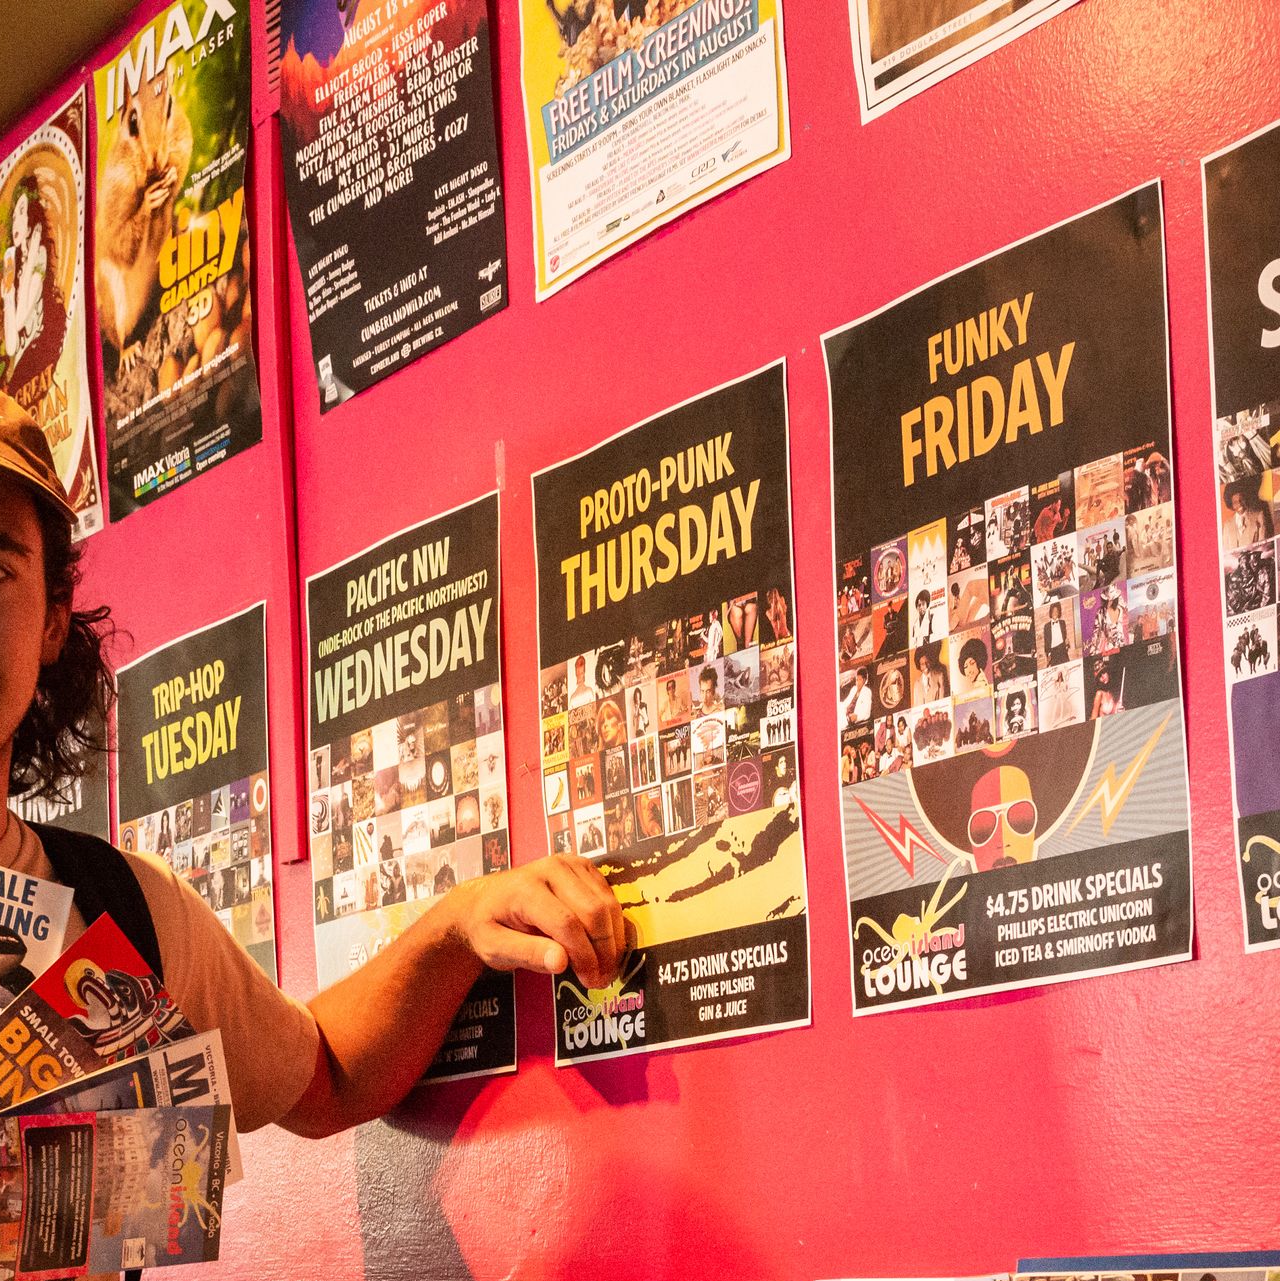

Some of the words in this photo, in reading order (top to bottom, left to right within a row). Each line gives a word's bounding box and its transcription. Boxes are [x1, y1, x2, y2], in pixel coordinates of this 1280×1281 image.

[191, 23, 234, 67] LASER
[398, 31, 432, 64] DEFUNK
[899, 33, 940, 58] DOUGLAS
[549, 84, 594, 136] FREE
[593, 61, 634, 104] FILM
[551, 116, 597, 159] FRIDAYS
[599, 108, 609, 124] &
[611, 62, 680, 117] SATURDAYS
[682, 49, 696, 70] IN
[699, 11, 753, 61] AUGUST
[158, 186, 244, 289] tiny
[186, 288, 214, 327] 3D
[927, 292, 1034, 384] FUNKY
[900, 341, 1076, 488] FRIDAY
[579, 431, 736, 540] PROTO-PUNK
[347, 553, 408, 618] PACIFIC
[413, 540, 450, 587] NW
[560, 478, 762, 623] THURSDAY
[364, 617, 374, 637] OF
[375, 609, 390, 631] THE
[391, 595, 424, 626] PACIFIC
[425, 569, 488, 611] NORTHWEST)
[151, 659, 225, 722] TRIP-HOP
[314, 598, 495, 725] WEDNESDAY
[141, 696, 243, 787] TUESDAY
[994, 945, 1021, 968] ICED
[1023, 941, 1042, 963] TEA
[1043, 941, 1054, 960] &
[1055, 930, 1115, 959] SMIRNOFF
[1116, 923, 1157, 950] VODKA
[997, 916, 1046, 942] PHILLIPS
[1047, 906, 1098, 934] ELECTRIC
[1099, 897, 1154, 926] UNICORN
[658, 958, 689, 986] $4.75
[690, 952, 729, 980] DRINK
[730, 939, 788, 974] SPECIALS
[690, 982, 719, 1004] HOYNE
[720, 975, 755, 999] PILSNER
[698, 1004, 716, 1022] GIN
